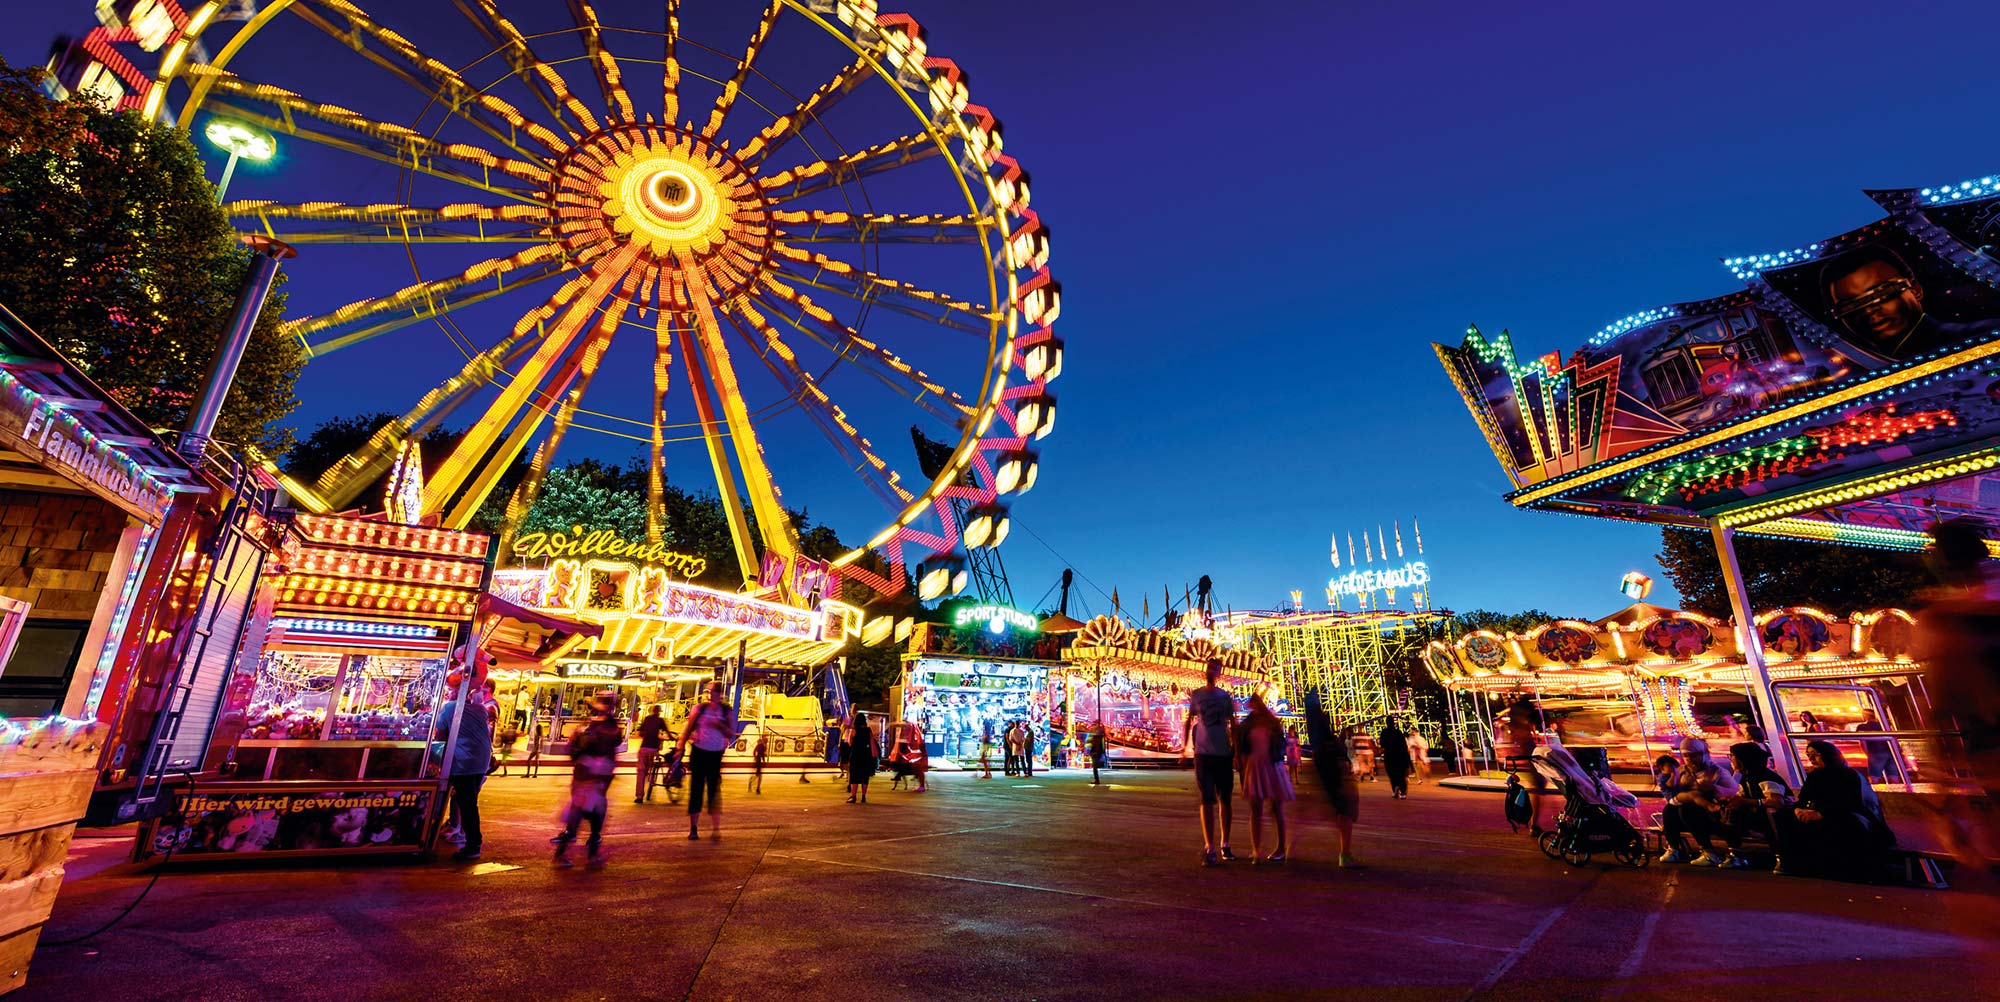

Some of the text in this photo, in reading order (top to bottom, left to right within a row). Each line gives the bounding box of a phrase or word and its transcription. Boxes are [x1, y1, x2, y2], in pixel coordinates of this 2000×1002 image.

[22, 408, 157, 512] Flammkuchen
[513, 525, 706, 577] Willenborg
[1376, 562, 1426, 589] MAUS
[956, 606, 1037, 631] SPORT STUDIO
[566, 663, 618, 678] KASSE
[179, 797, 232, 812] Hier
[235, 796, 289, 811] wird
[291, 797, 395, 813] gewonnen
